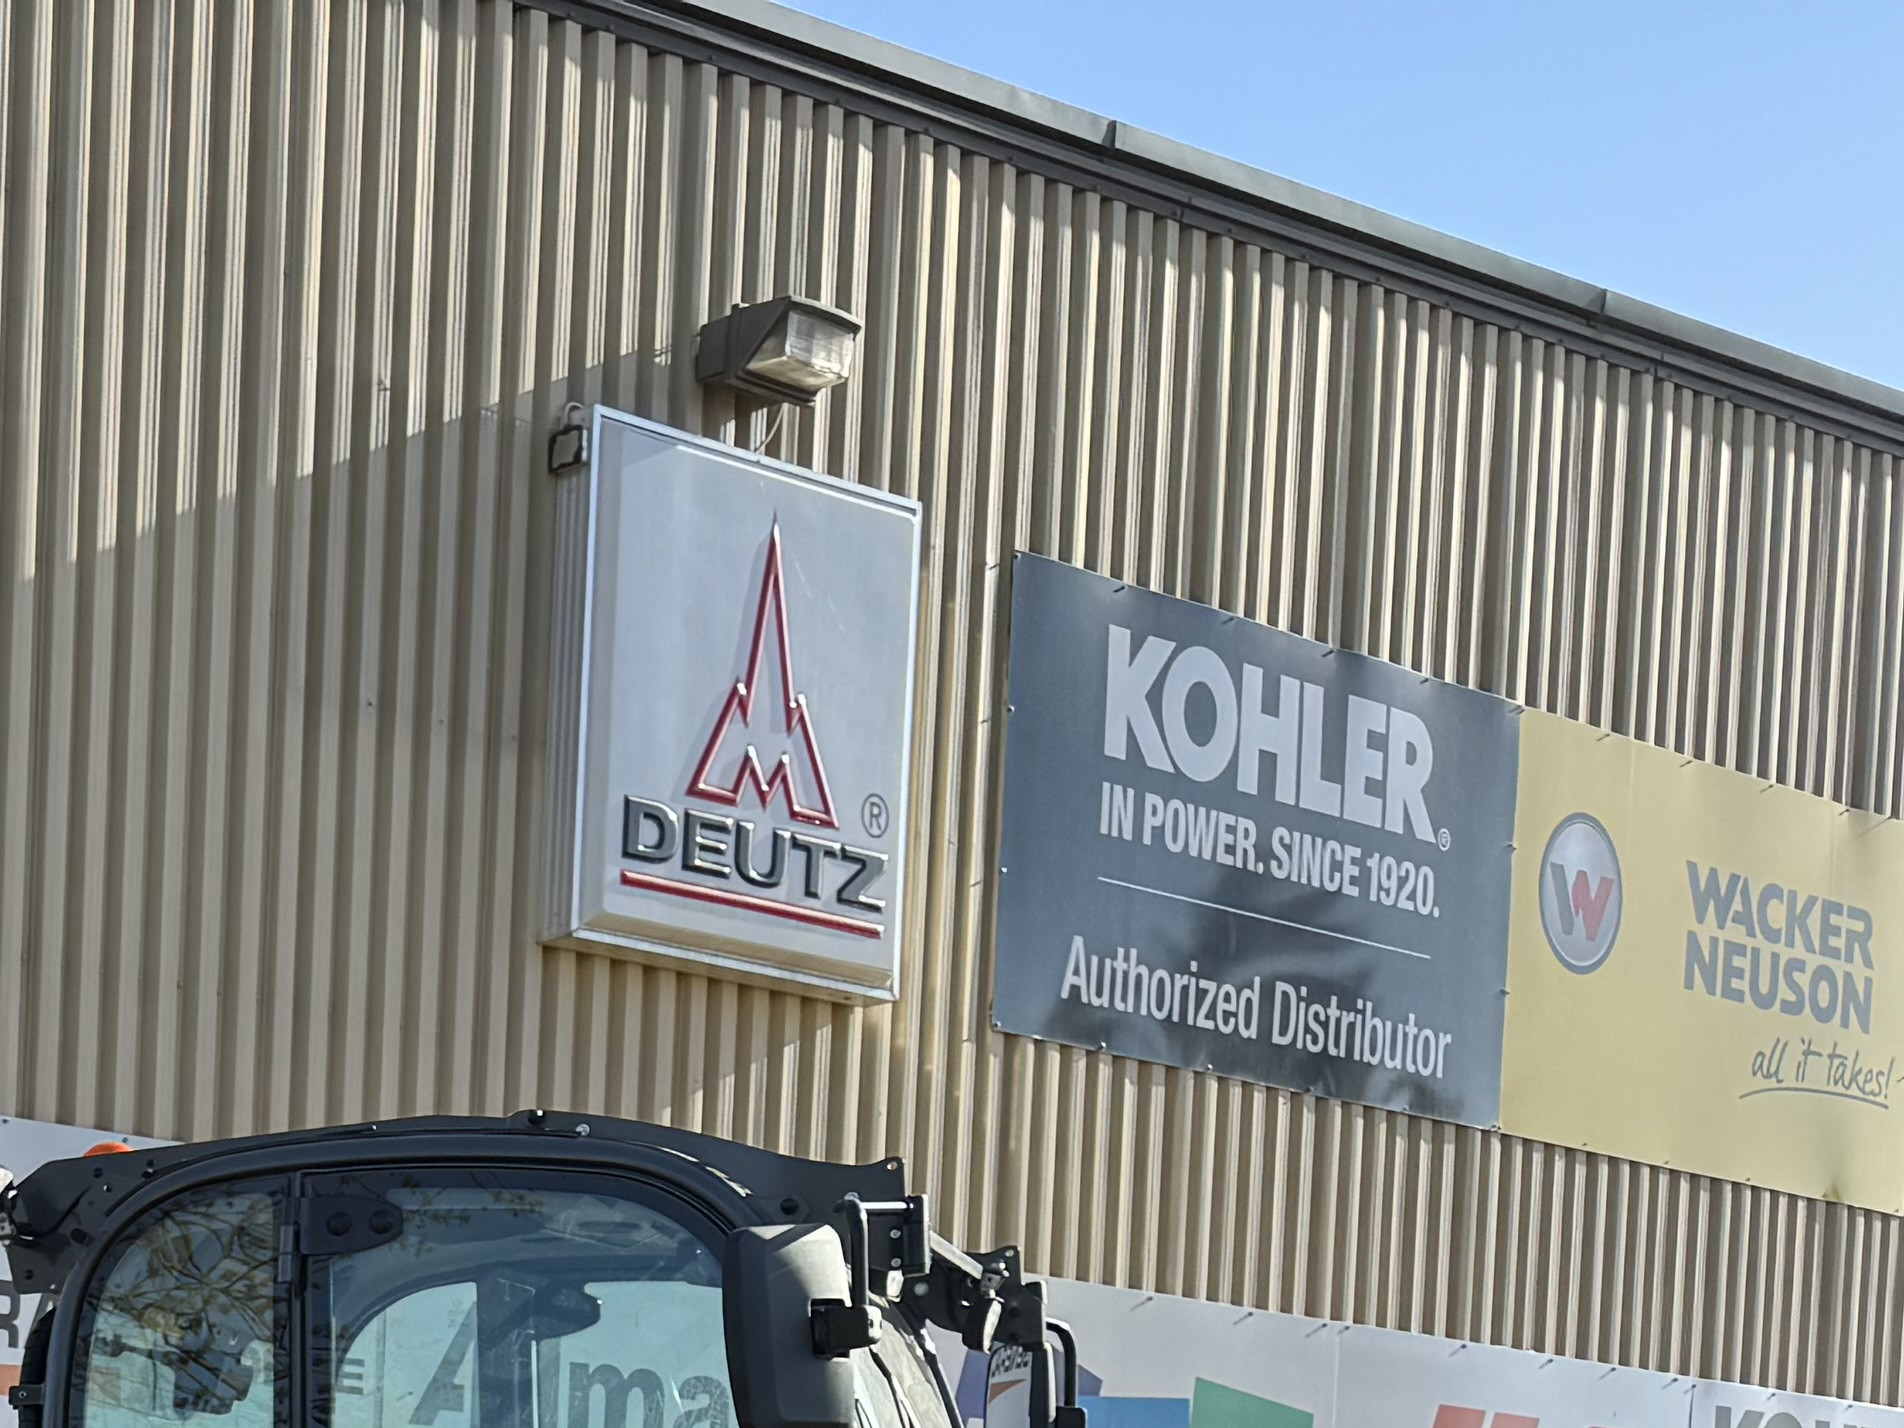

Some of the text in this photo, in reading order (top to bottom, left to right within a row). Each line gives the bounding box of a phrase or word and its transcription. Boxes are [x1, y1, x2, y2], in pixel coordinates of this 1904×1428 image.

[1104, 624, 1438, 845] KOHLER
[622, 793, 889, 914] DEUTZ
[1100, 781, 1441, 919] IN POWER. SINCE 1920.
[1686, 860, 1874, 970] WACKER
[1059, 934, 1453, 1080] Authorized Distributor
[1683, 929, 1874, 1035] NEUSON
[1751, 1037, 1788, 1084] all
[1796, 1037, 1823, 1083] it
